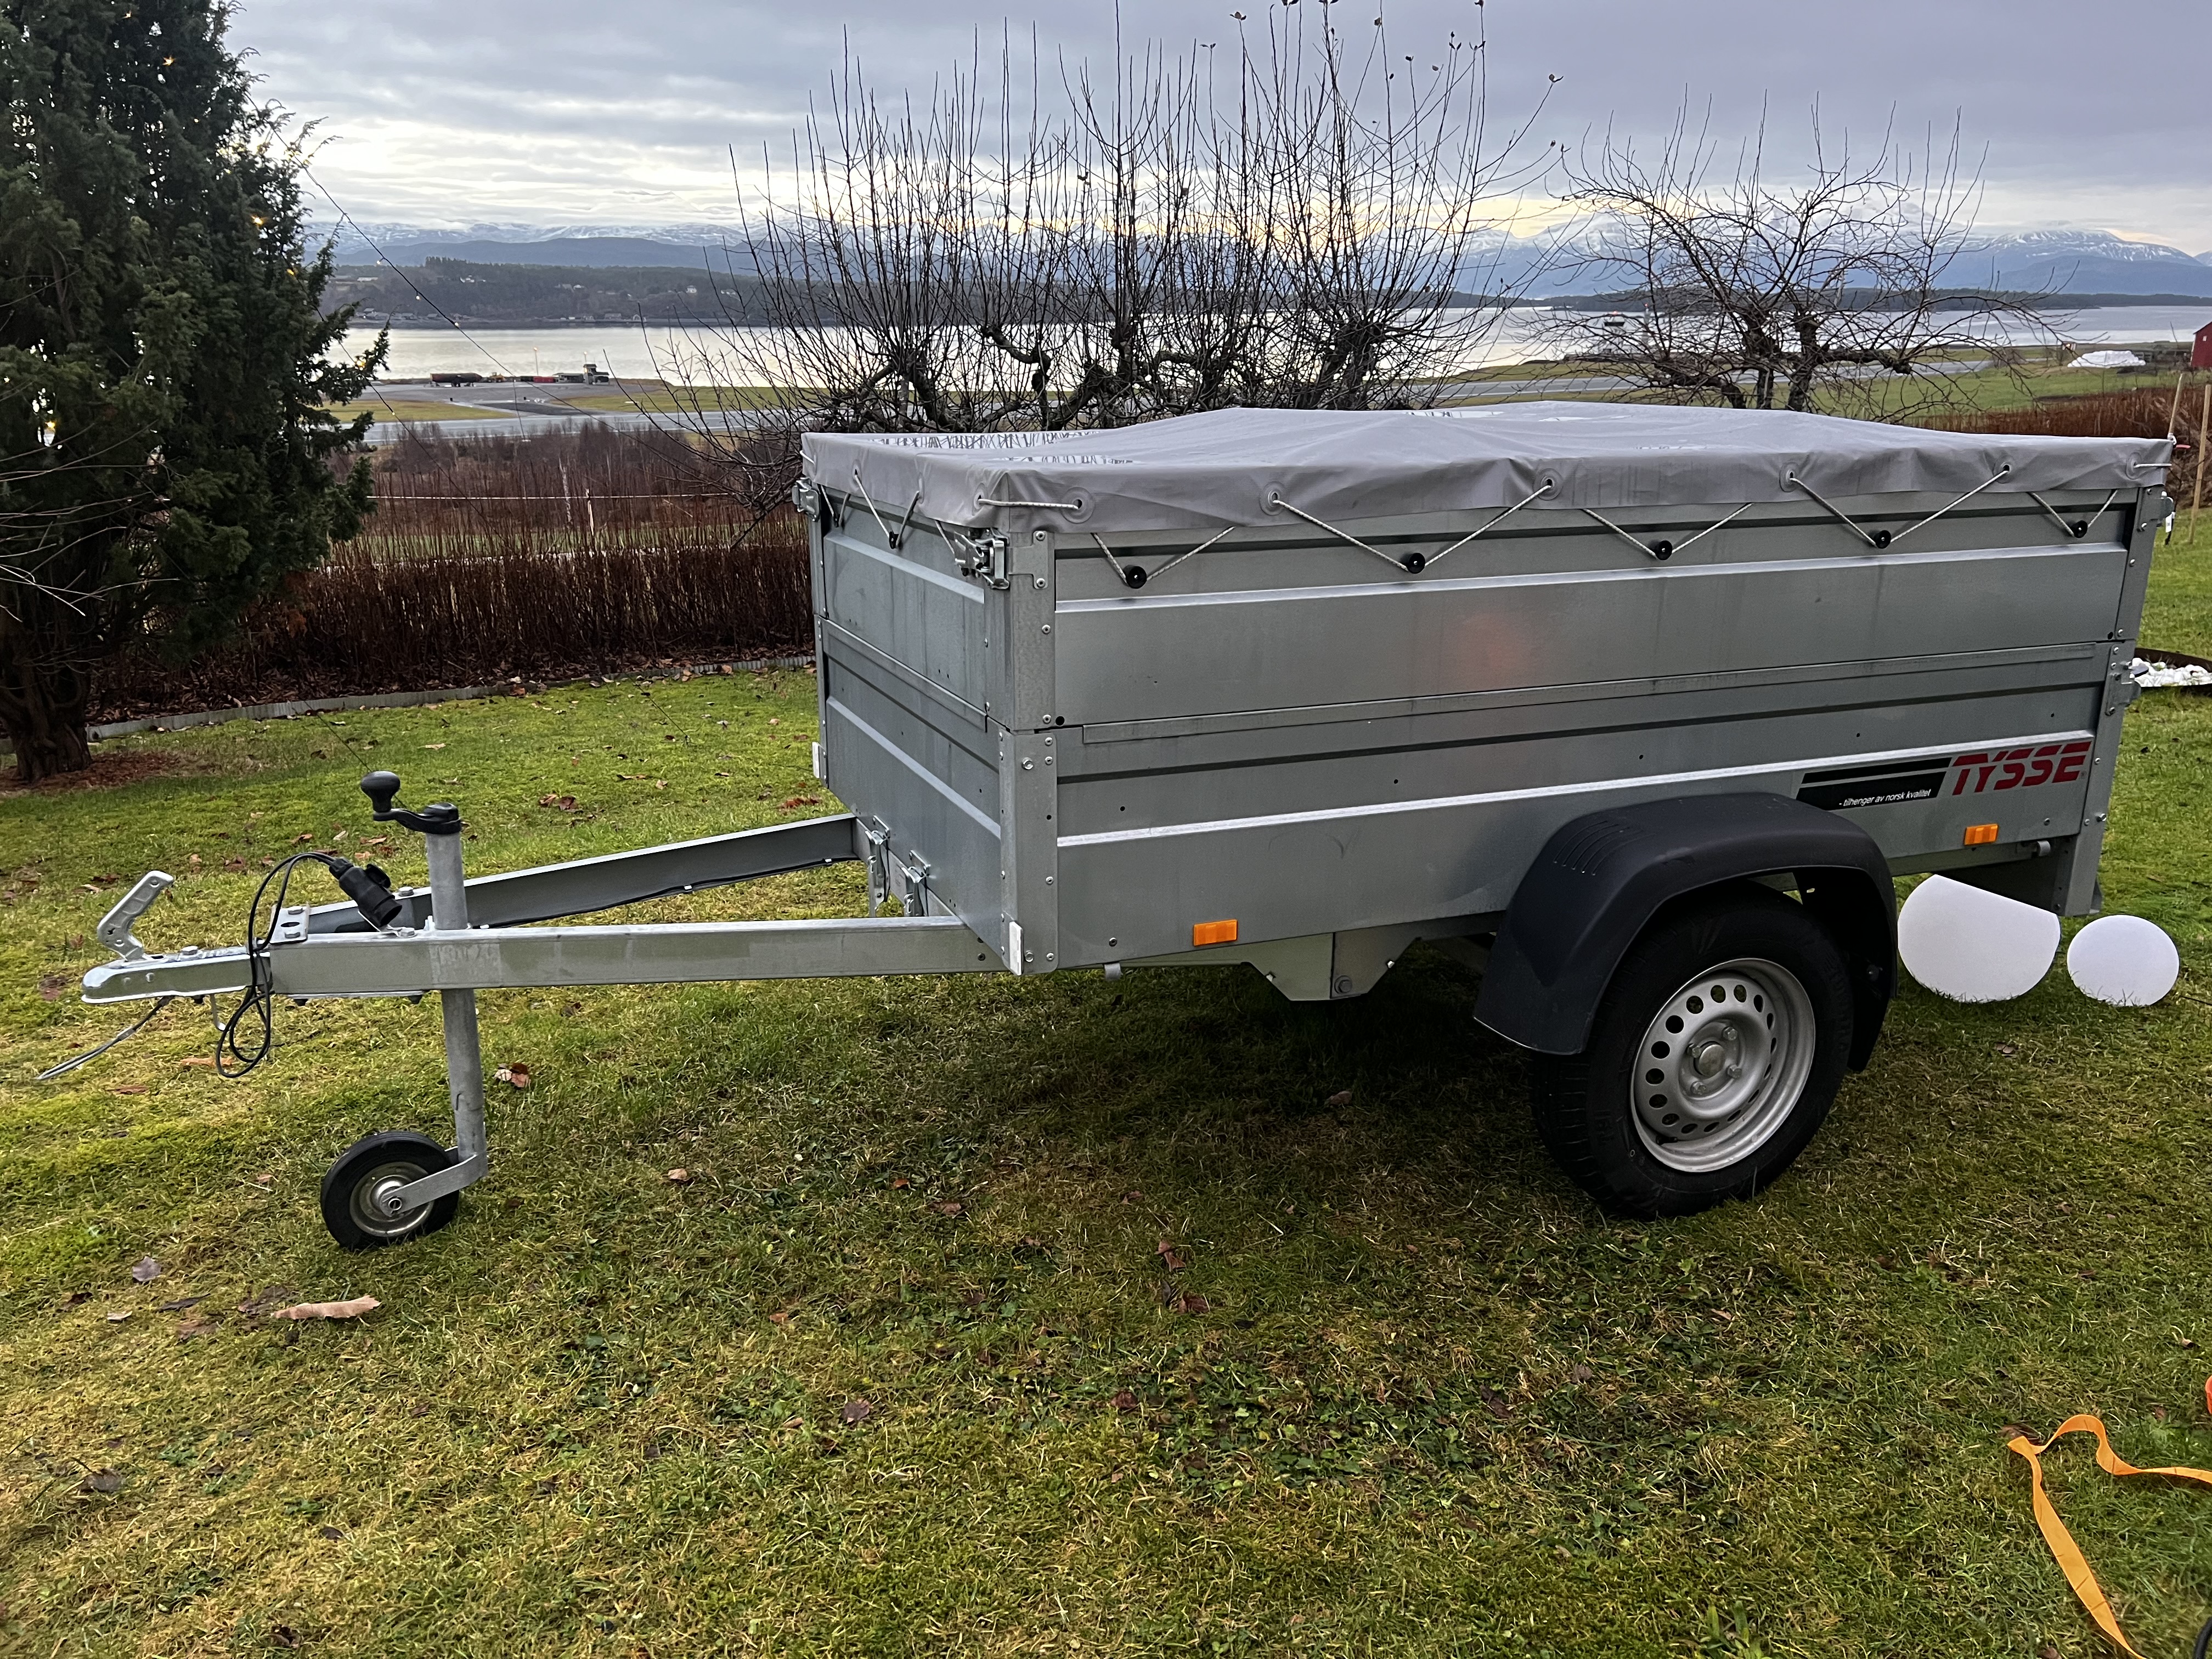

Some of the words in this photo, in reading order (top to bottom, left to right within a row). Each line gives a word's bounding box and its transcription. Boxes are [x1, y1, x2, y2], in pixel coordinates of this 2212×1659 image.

[1951, 741, 2092, 795] TYSSE
[1843, 797, 1875, 806] tilhenger
[1884, 792, 1905, 802] norsk
[1905, 788, 1932, 799] kvalitet
